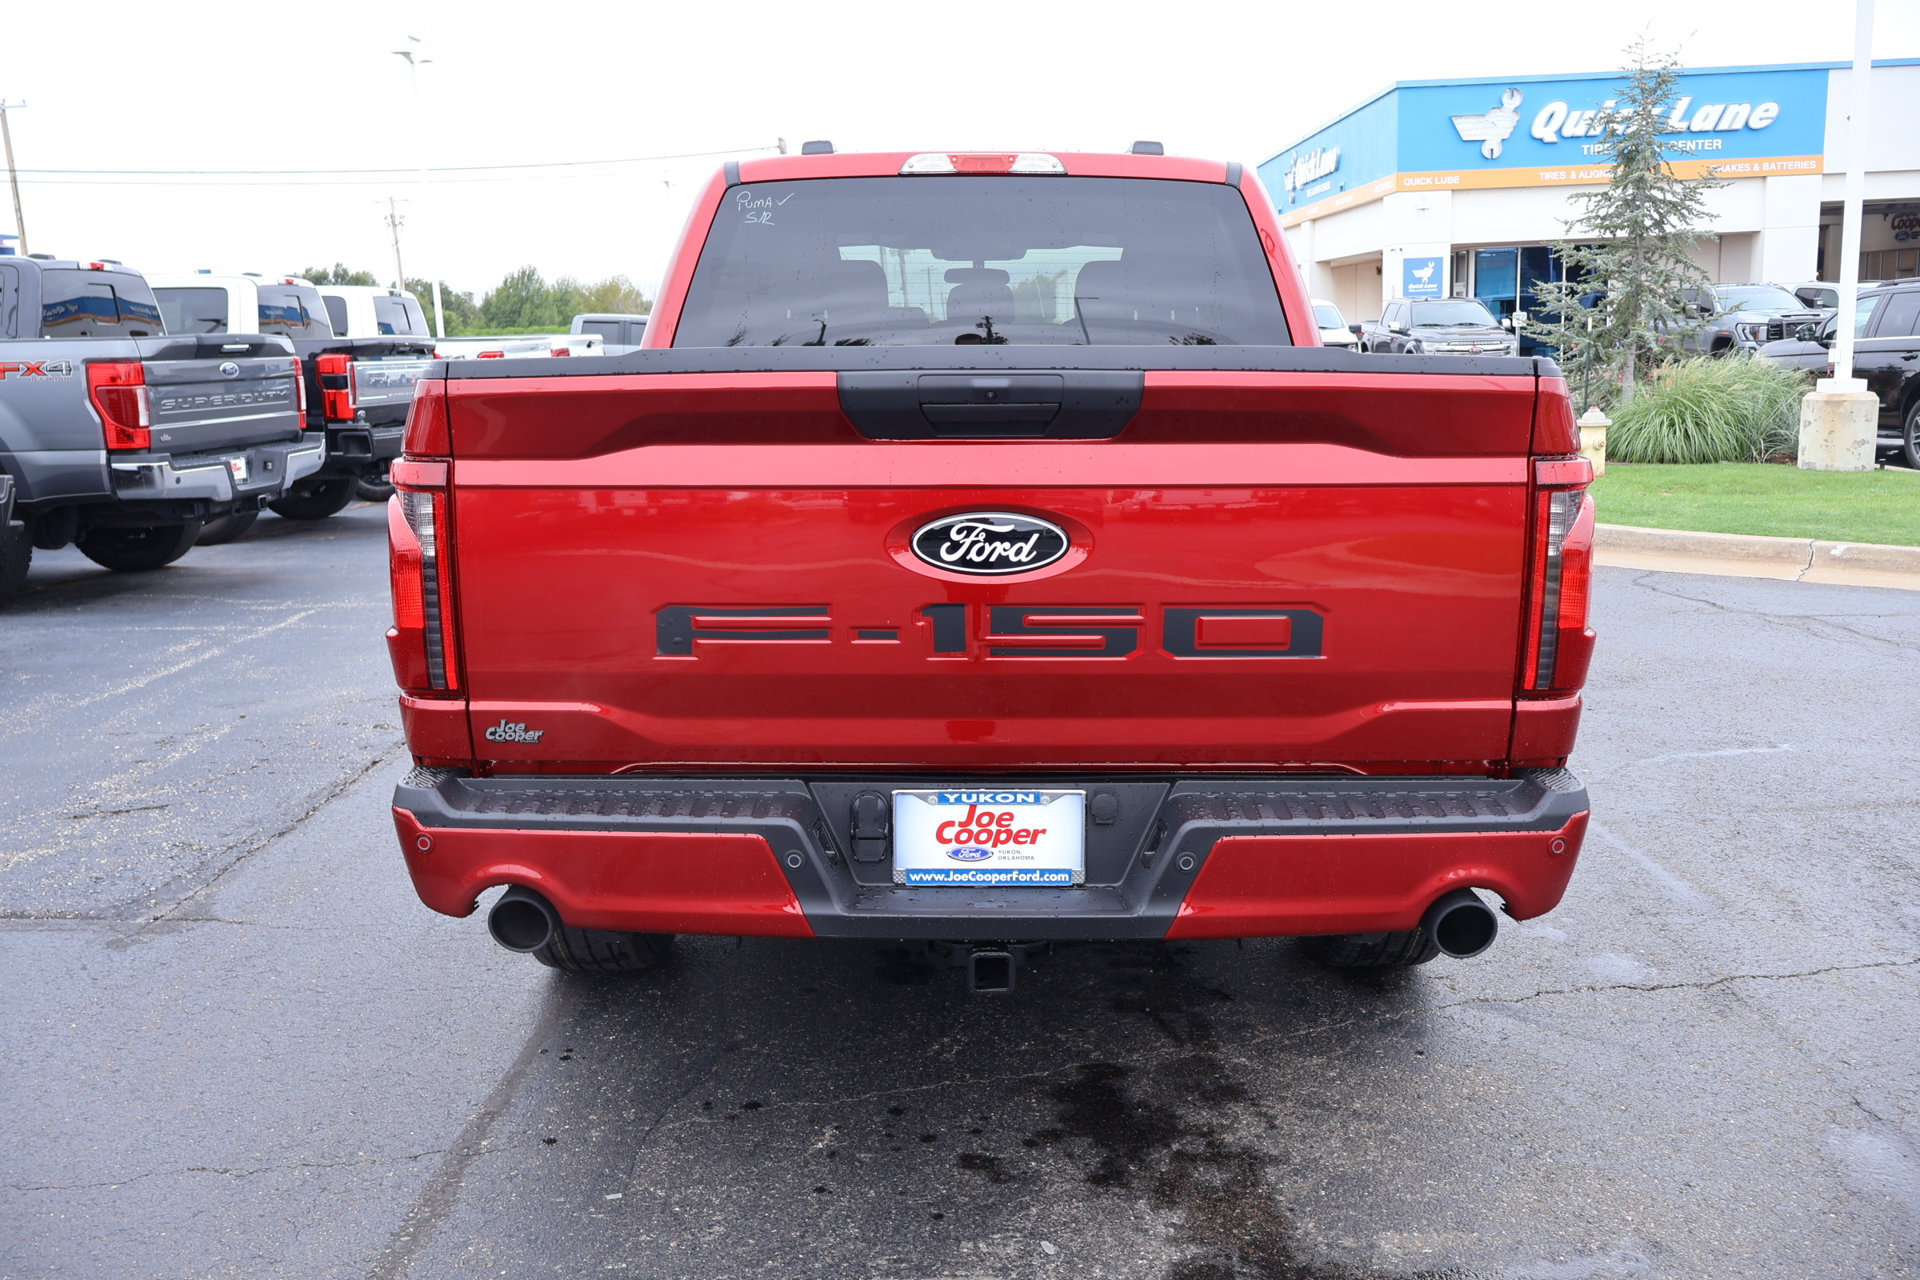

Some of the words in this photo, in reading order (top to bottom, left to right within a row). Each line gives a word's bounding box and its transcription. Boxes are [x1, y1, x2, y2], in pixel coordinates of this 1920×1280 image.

[1666, 96, 1780, 133] Lane
[1670, 139, 1723, 151] CENTER
[1753, 162, 1760, 171] &
[1762, 160, 1817, 171] BATTERIES
[1403, 177, 1433, 186] QUICK
[1435, 175, 1461, 185] LUBE
[1539, 171, 1566, 181] TIRES
[1569, 169, 1578, 179] &
[161, 394, 238, 410] SUPER
[240, 388, 289, 403] DUTY
[940, 522, 1040, 562] Ford
[654, 603, 1327, 661] F-150
[497, 719, 527, 732] Joe
[485, 727, 544, 741] Cooper
[943, 793, 1035, 803] YUKON
[958, 804, 1015, 828] Joe
[935, 820, 1047, 848] Cooper
[958, 848, 982, 858] Ford
[908, 871, 1070, 884] www.JoeCooperFord.com
